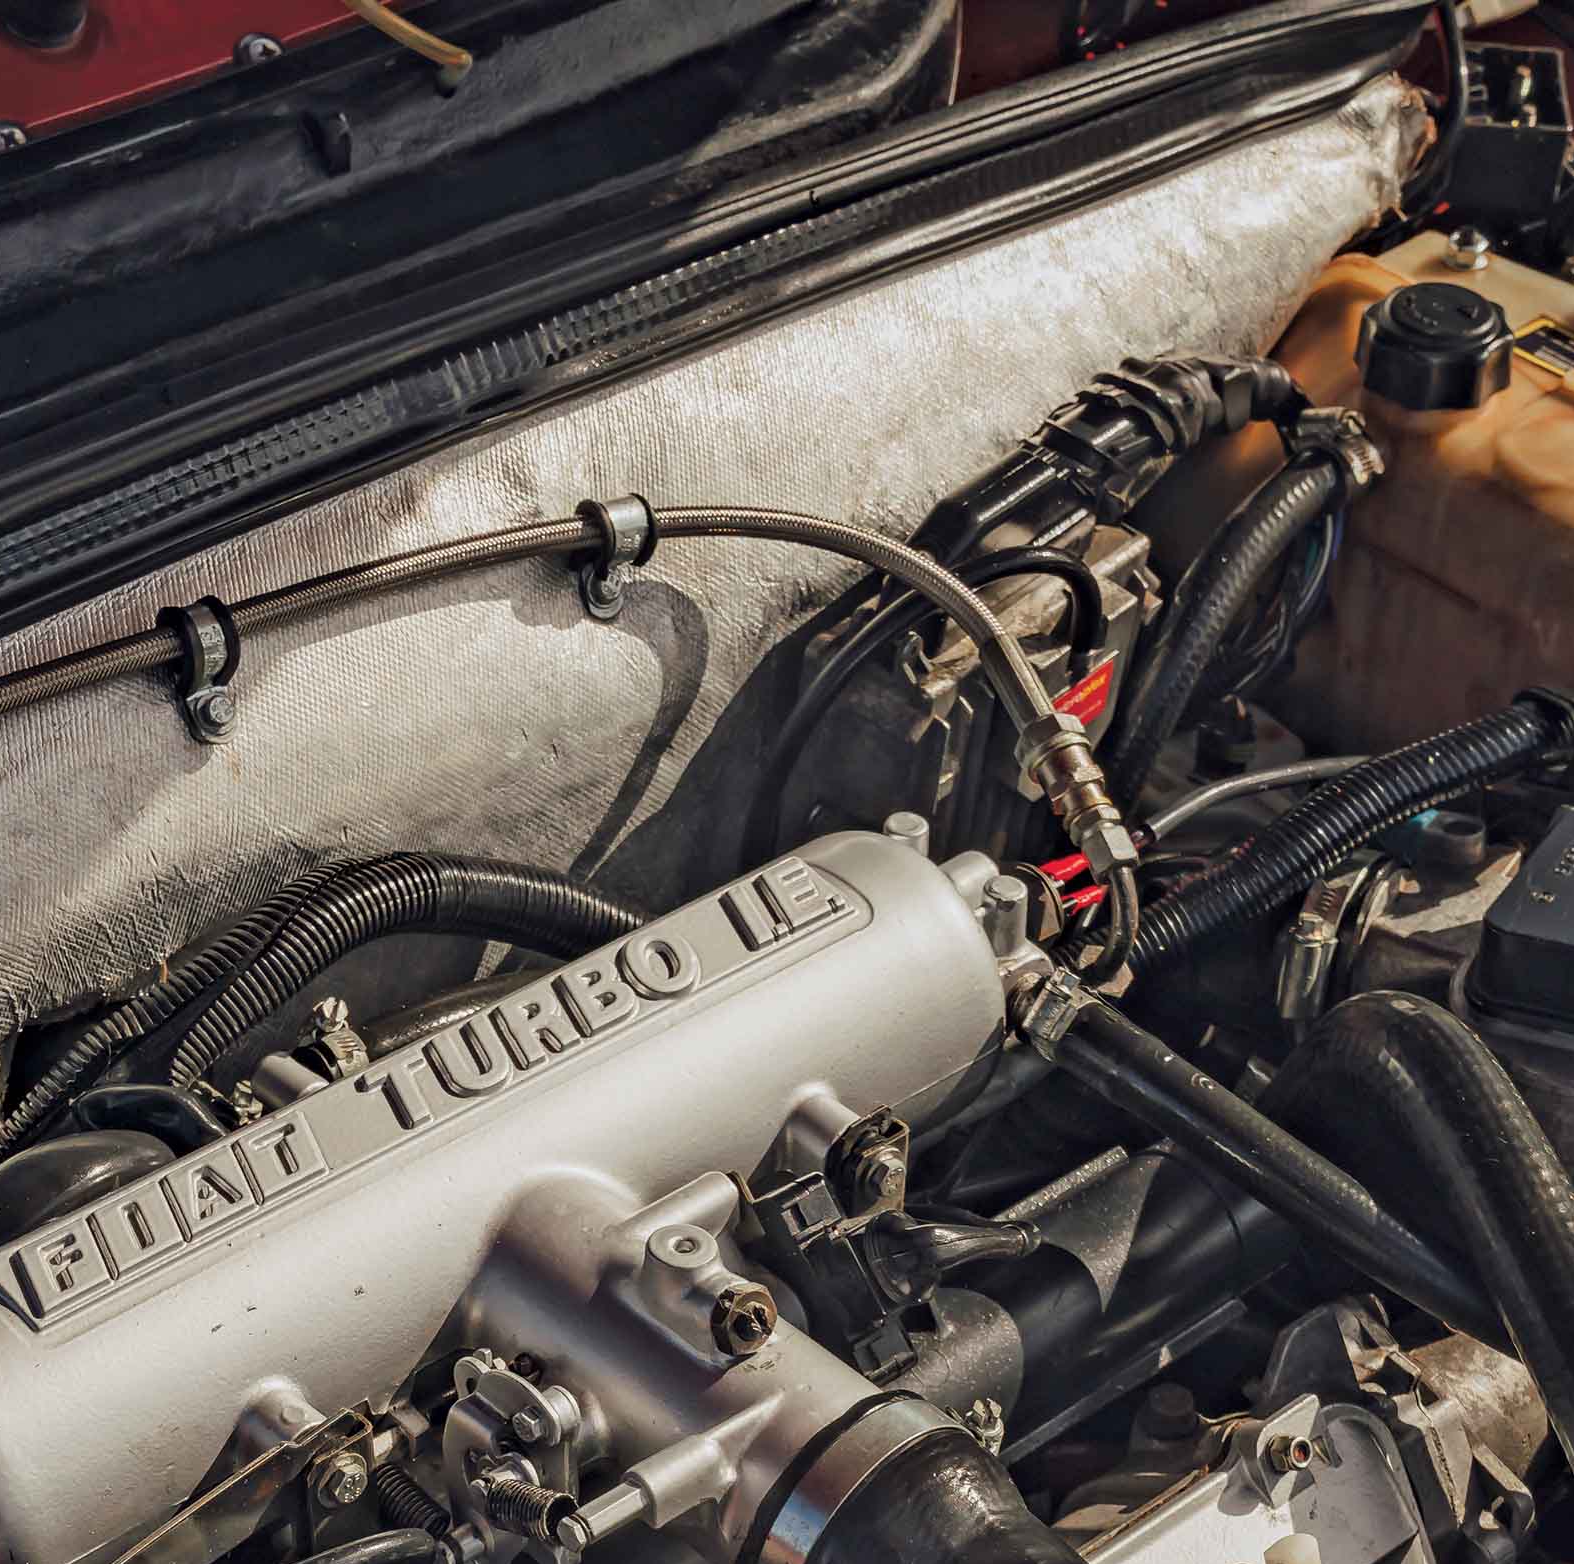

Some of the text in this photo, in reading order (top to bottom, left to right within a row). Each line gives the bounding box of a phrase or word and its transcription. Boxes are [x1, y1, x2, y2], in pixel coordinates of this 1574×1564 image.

[37, 856, 846, 1292] FIAT TURBO I.E.
